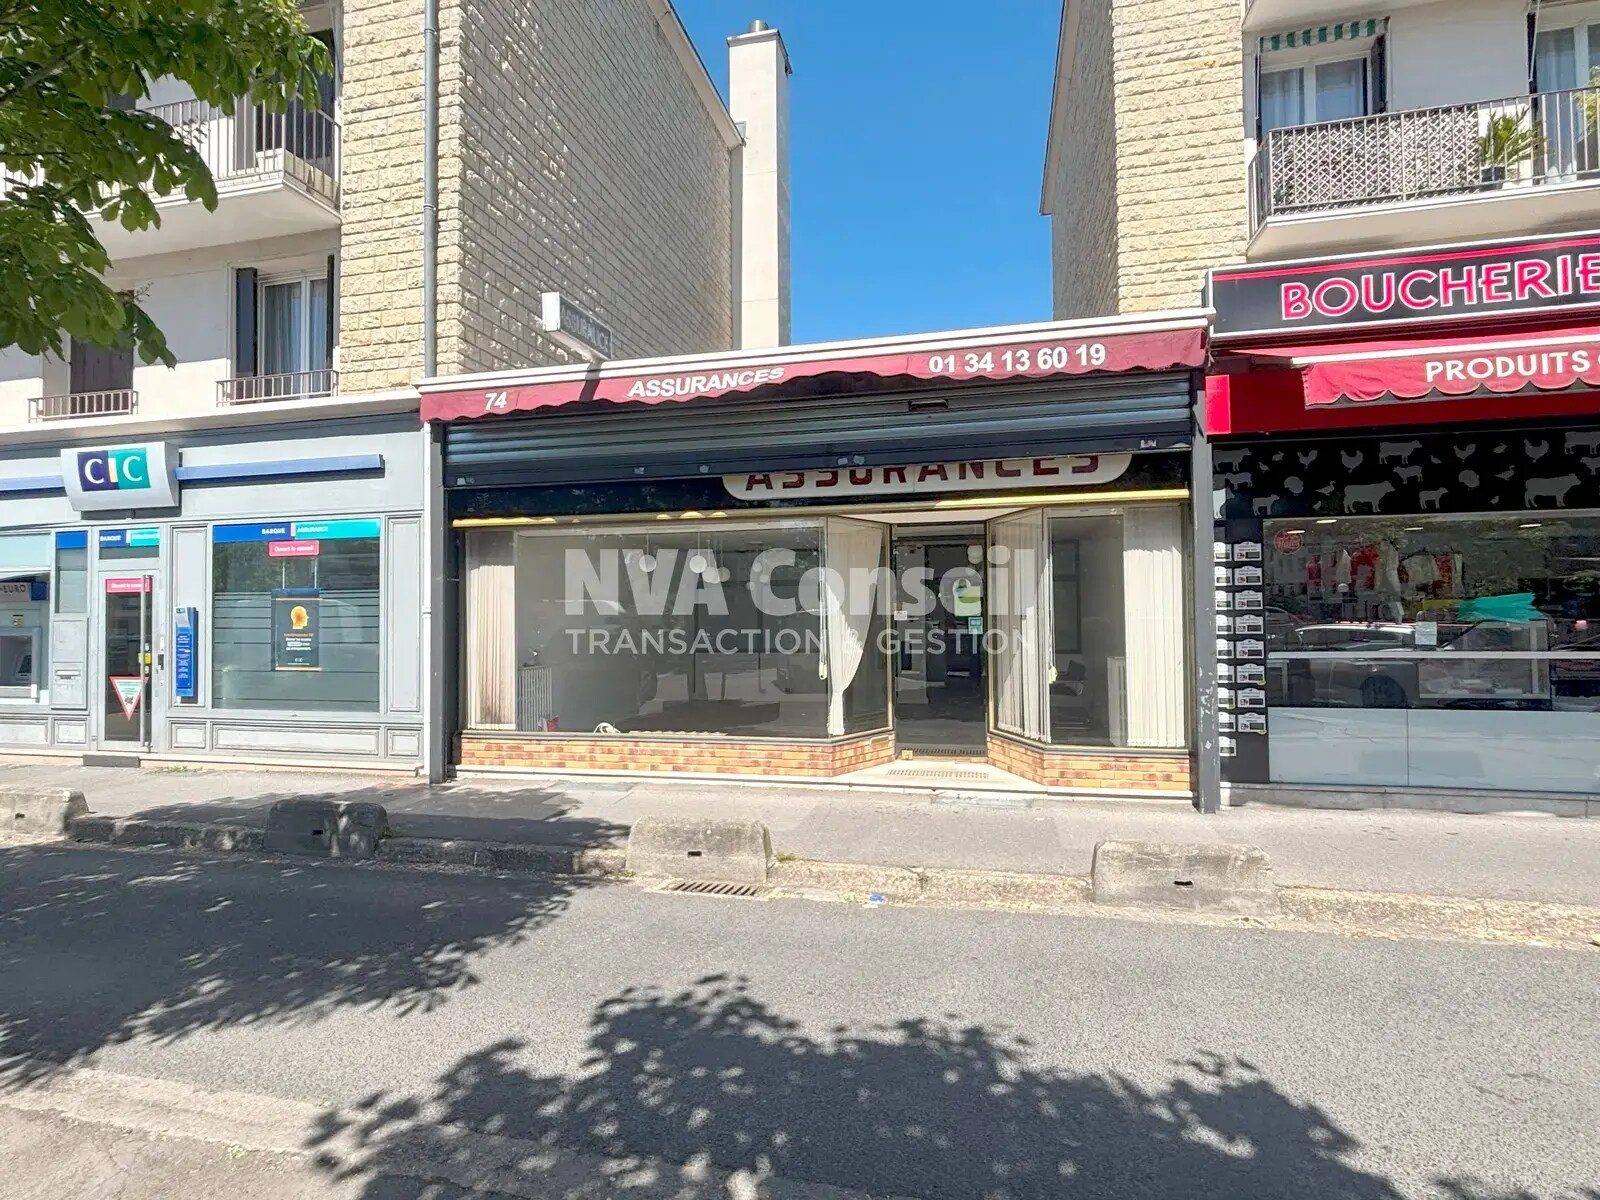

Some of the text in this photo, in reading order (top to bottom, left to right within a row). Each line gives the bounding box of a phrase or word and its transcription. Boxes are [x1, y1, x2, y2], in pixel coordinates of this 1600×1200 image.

[1281, 253, 1600, 321] BOUCHERIE
[928, 343, 1106, 373] 01 34 13 60 19
[1425, 350, 1591, 383] PRODUITS
[628, 367, 785, 398] ASSURANCES
[485, 391, 508, 411] 74
[84, 456, 143, 484] CIC
